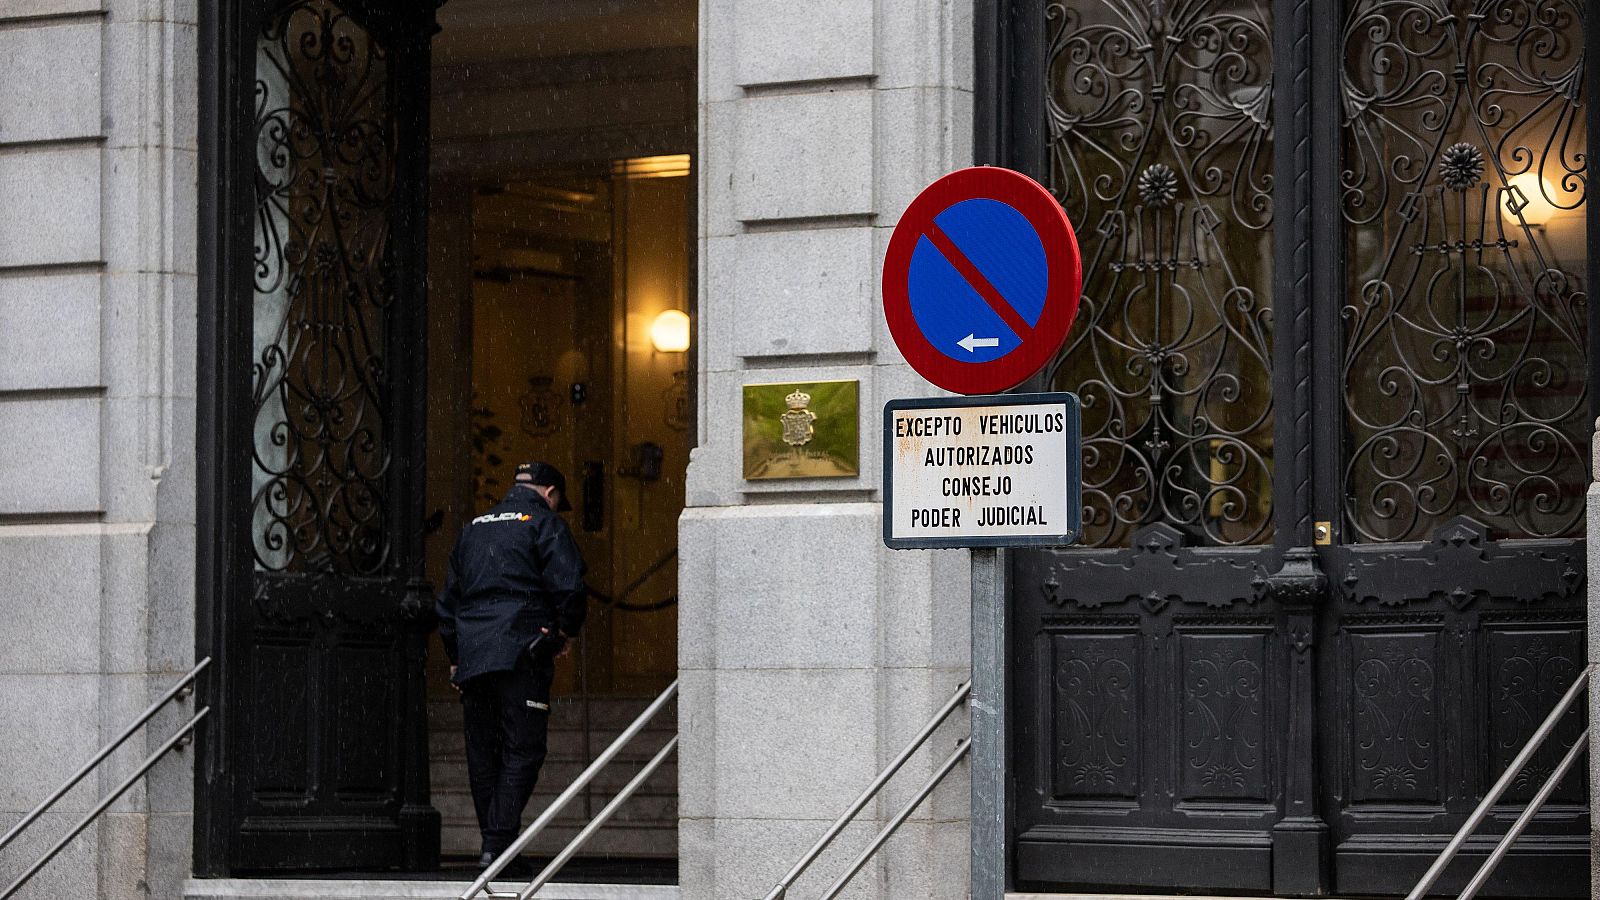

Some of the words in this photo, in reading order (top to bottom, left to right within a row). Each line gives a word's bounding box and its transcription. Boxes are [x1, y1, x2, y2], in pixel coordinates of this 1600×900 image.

[895, 416, 962, 437] EXCEPTO
[980, 413, 1064, 435] VEHICULOS
[924, 445, 1034, 467] AUTORIZADOS
[942, 476, 1012, 497] CONSEJO
[471, 512, 523, 525] POLICIA
[911, 507, 961, 528] PODER
[977, 505, 1048, 527] JUDICIAL
